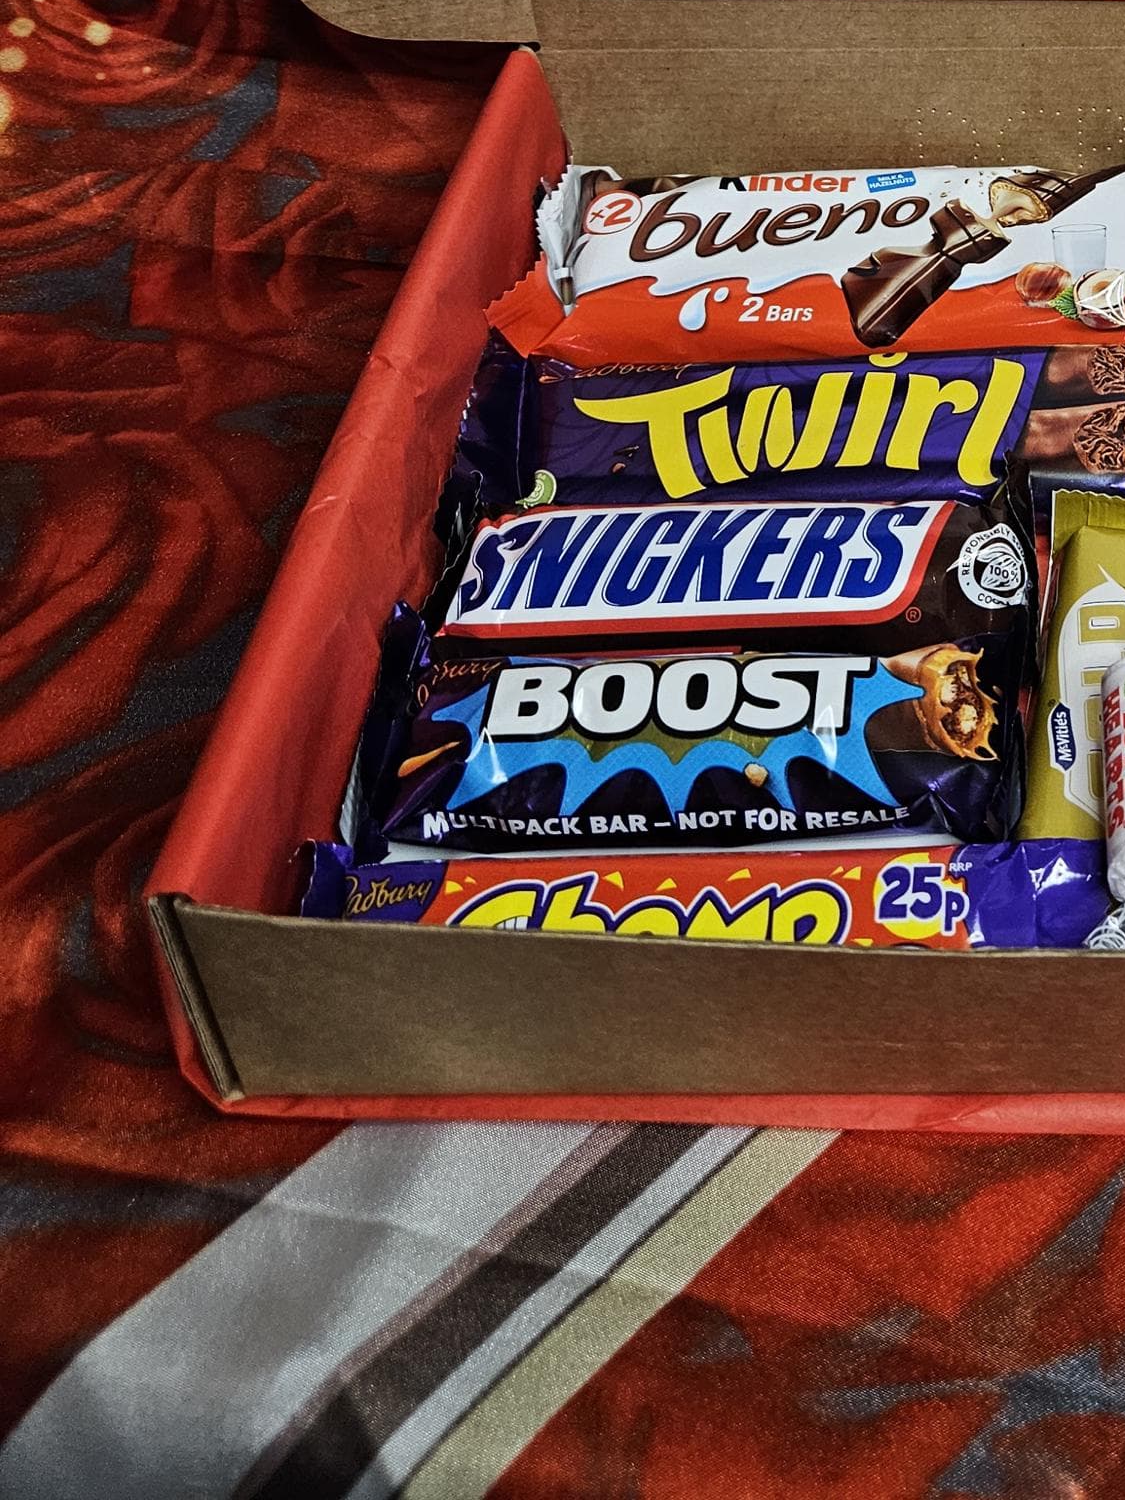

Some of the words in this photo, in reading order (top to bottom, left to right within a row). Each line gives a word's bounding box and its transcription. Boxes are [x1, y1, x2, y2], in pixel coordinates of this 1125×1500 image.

[629, 191, 931, 263] bueno
[739, 296, 765, 323] 2
[766, 304, 814, 324] Bars
[573, 353, 1025, 499] Twirl
[458, 505, 924, 611] SNICKERS
[487, 657, 872, 737] BOOST
[423, 812, 582, 839] MULTIPACK
[590, 815, 648, 834] BAR
[679, 811, 735, 831] NOT
[744, 808, 797, 831] FOR
[805, 806, 910, 830] RESALE
[878, 865, 967, 933] 25p
[950, 862, 973, 873] RRP
